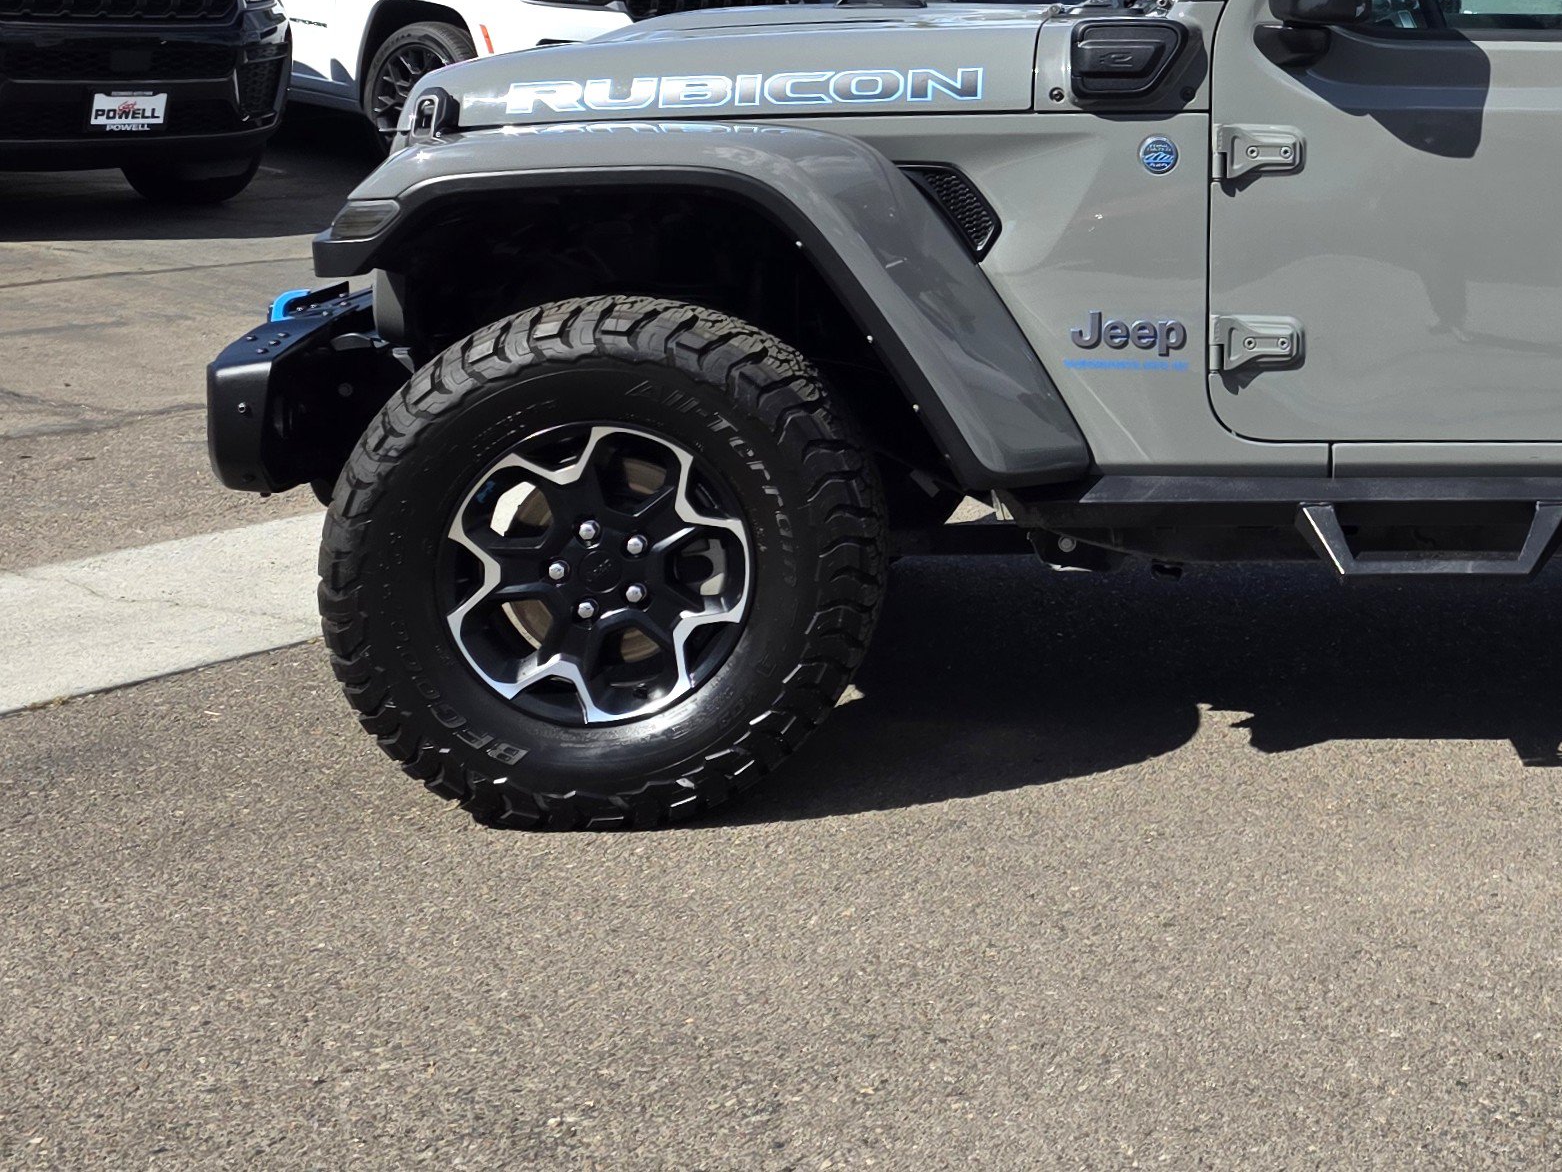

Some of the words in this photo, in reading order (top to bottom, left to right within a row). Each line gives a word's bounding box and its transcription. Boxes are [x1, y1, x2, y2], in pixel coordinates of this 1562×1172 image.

[505, 67, 984, 114] RUBICON
[94, 108, 160, 120] POWELL
[106, 123, 151, 131] POWELL
[1070, 309, 1187, 357] Jeep
